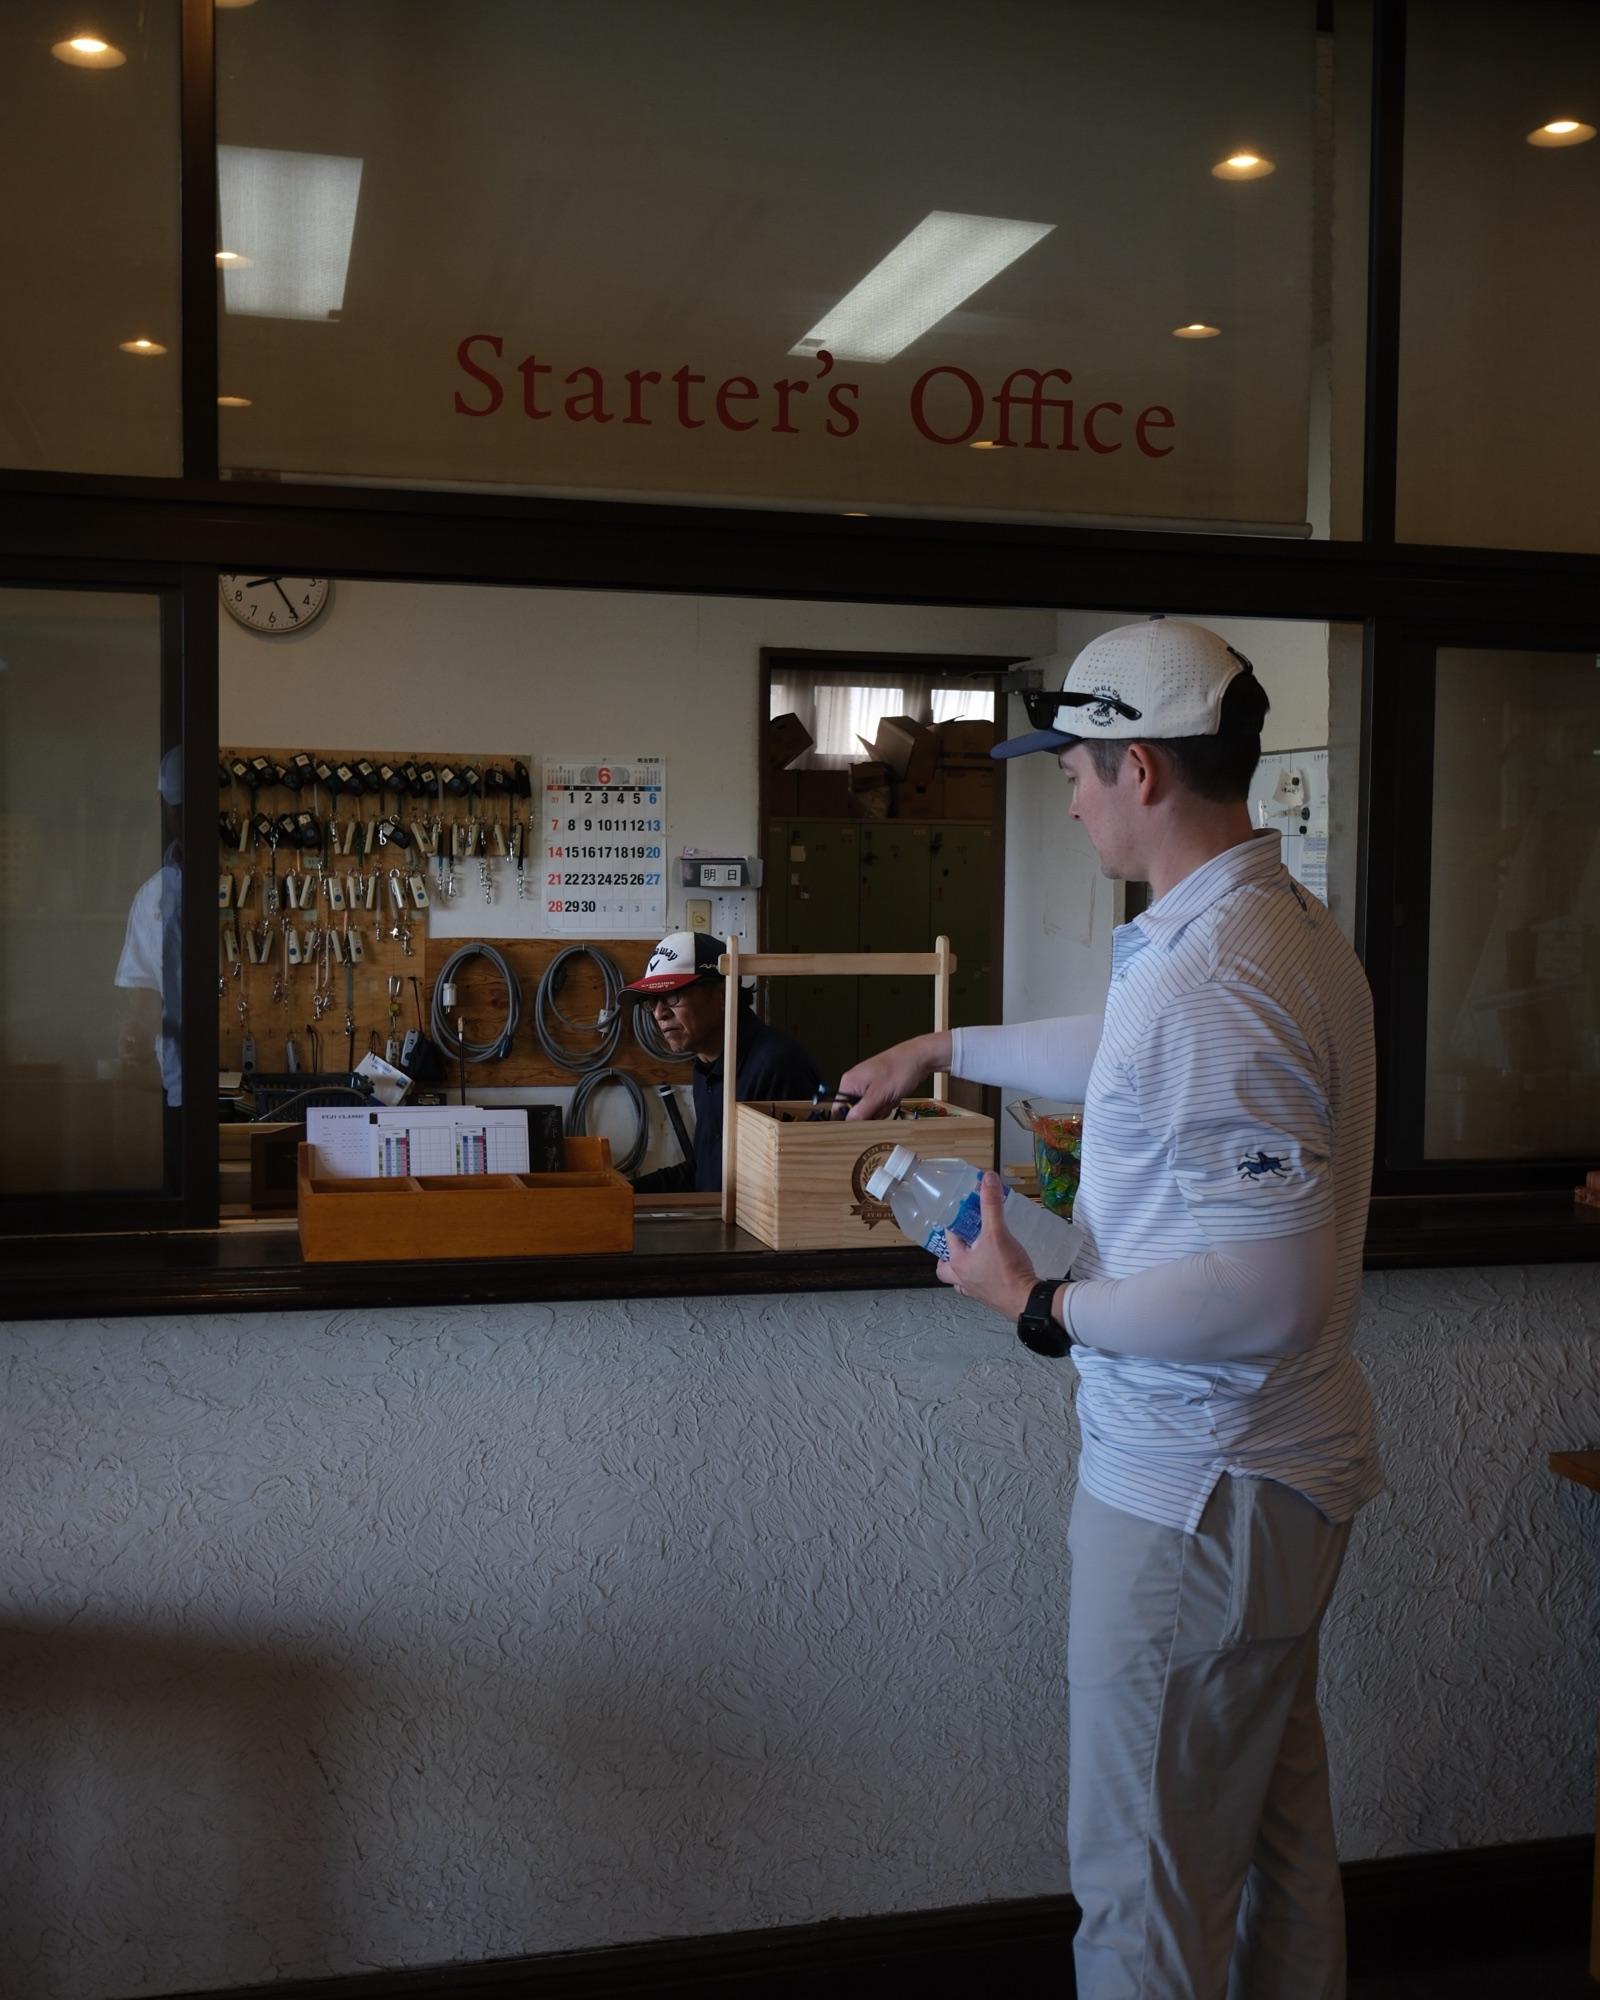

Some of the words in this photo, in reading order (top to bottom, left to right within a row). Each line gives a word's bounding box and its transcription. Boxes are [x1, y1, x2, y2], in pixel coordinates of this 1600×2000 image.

[454, 334, 860, 437] Starter's
[910, 366, 1176, 458] Office
[235, 590, 242, 602] 8
[303, 594, 310, 605] 4
[250, 605, 258, 617] 7
[269, 611, 276, 623] 6
[598, 767, 612, 784] 6
[569, 793, 574, 804] 1
[584, 793, 593, 804] 2
[601, 793, 609, 804] 3
[617, 793, 625, 804] 4
[633, 793, 641, 804] 5
[649, 794, 657, 804] 6
[552, 820, 559, 830] 7
[568, 820, 576, 831] 8
[584, 820, 592, 831] 9
[598, 820, 612, 831] 10
[614, 820, 627, 831] 11
[630, 820, 644, 831] 12
[646, 820, 661, 831] 13
[548, 847, 563, 858] 14
[565, 847, 579, 858] 15
[581, 847, 596, 858] 16
[598, 847, 612, 858] 17
[614, 847, 629, 858] 18
[630, 847, 644, 858] 19
[646, 847, 660, 858] 20
[548, 874, 561, 885] 21
[565, 874, 580, 885] 22
[581, 874, 596, 885] 23
[597, 874, 612, 885] 24
[614, 874, 628, 885] 25
[630, 874, 644, 885] 26
[646, 874, 660, 885] 27
[548, 901, 563, 912] 28
[565, 901, 580, 912] 29
[581, 901, 596, 912] 30
